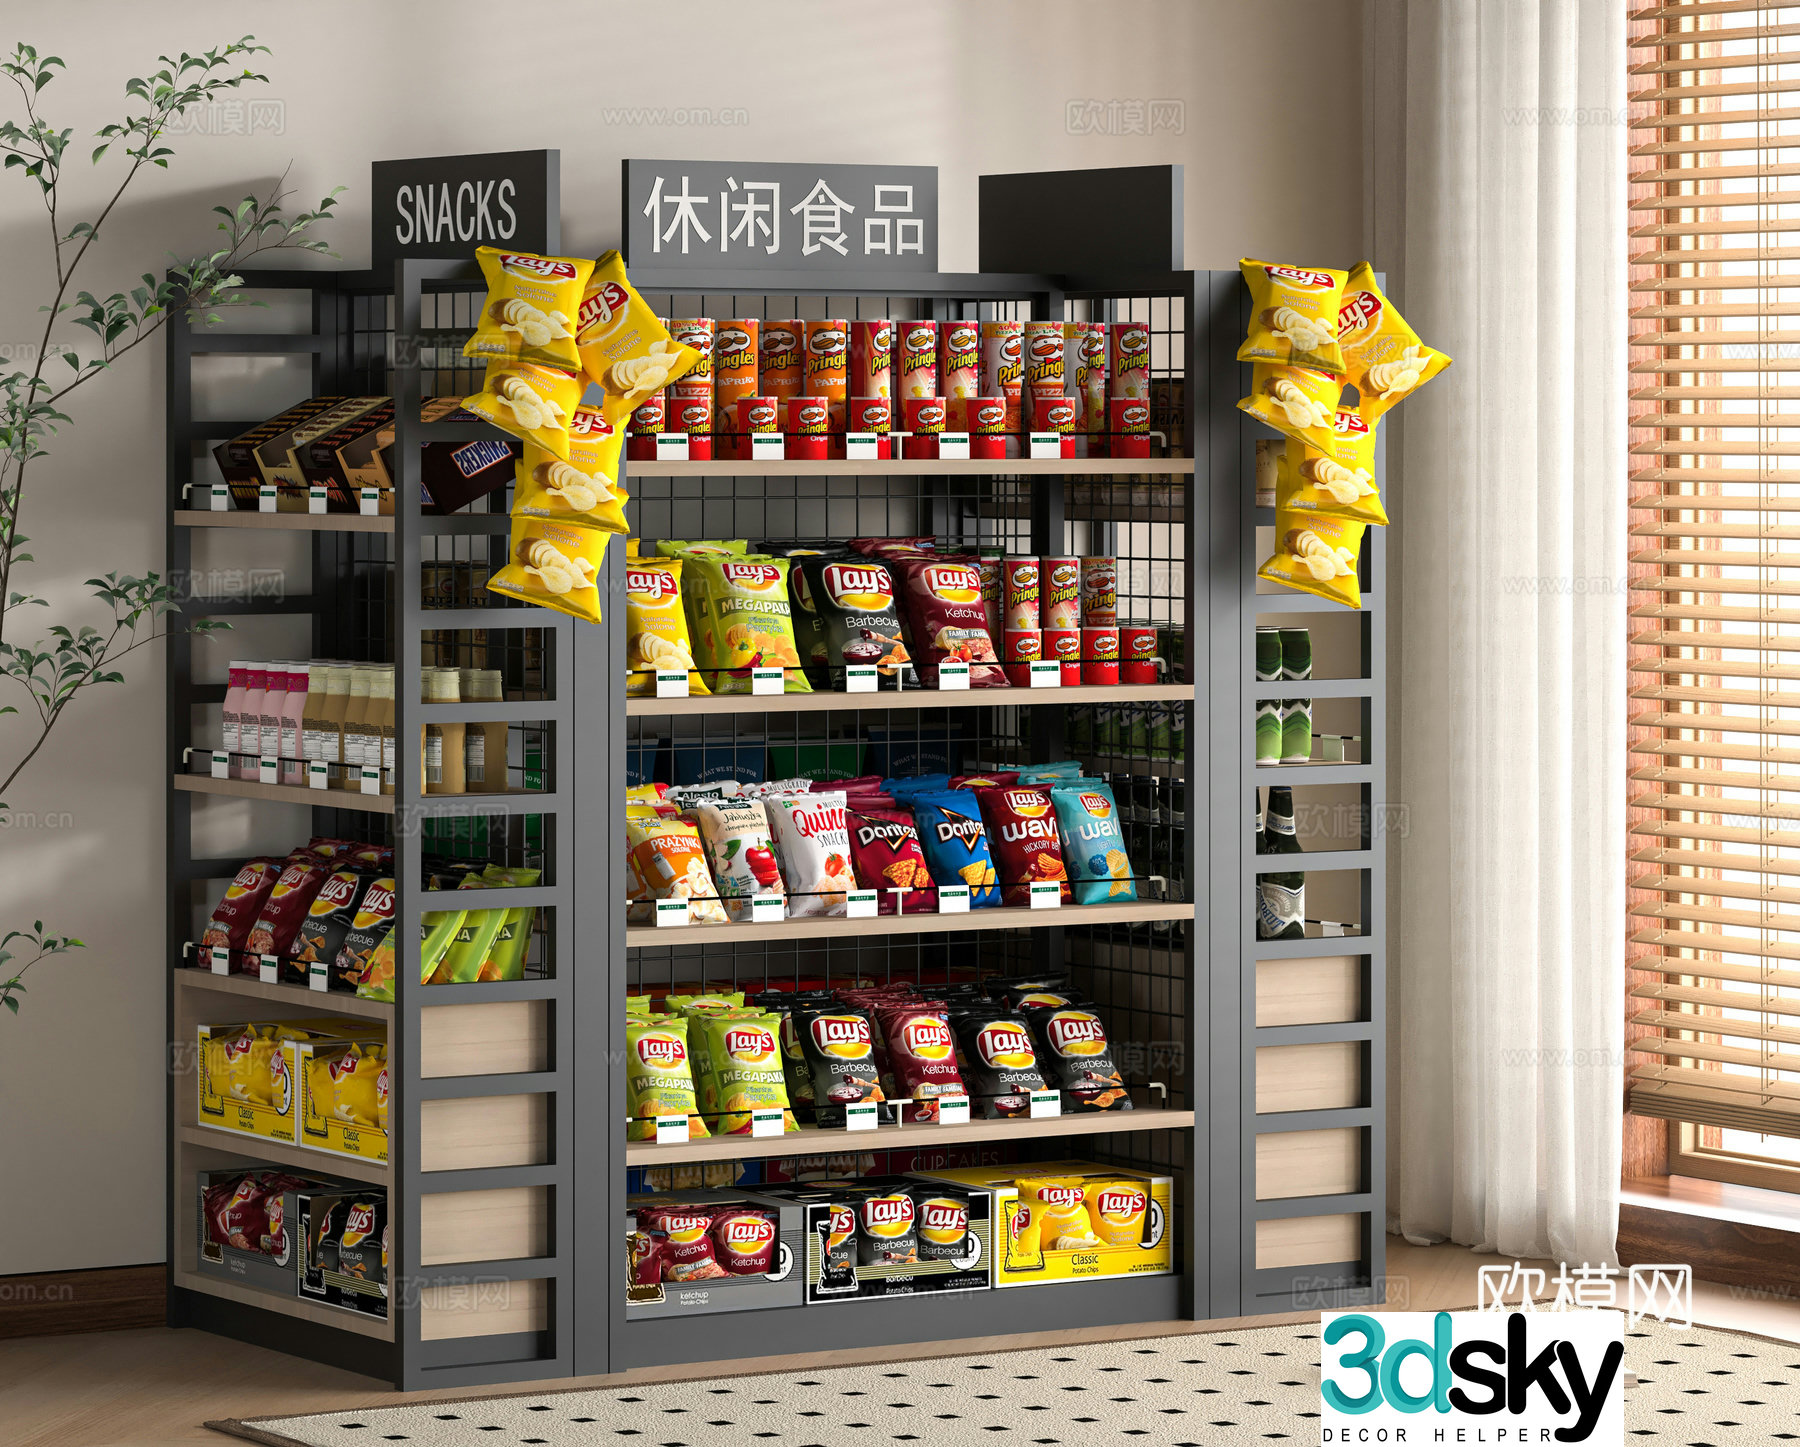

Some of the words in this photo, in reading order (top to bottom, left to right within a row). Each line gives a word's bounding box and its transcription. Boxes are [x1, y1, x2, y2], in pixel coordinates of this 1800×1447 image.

[396, 178, 516, 245] SNACKS
[643, 175, 925, 257] 休闲食品
[500, 254, 574, 277] Lay's
[1269, 266, 1330, 286] Lay's
[577, 283, 622, 337] ay's
[729, 563, 775, 585] Lay's
[832, 567, 891, 598] Lay's
[932, 568, 978, 591] Lay's
[627, 572, 674, 599] ay's
[845, 616, 900, 629] Barbecue
[944, 608, 985, 623] Ketchup
[682, 791, 719, 799] Alesto
[1009, 791, 1046, 808] Lay's
[1086, 795, 1110, 810] Lay's
[857, 823, 919, 846] Doritos
[819, 1019, 870, 1047] Lay's
[910, 1024, 949, 1050] Lay's
[1054, 1018, 1103, 1049] Lay's
[643, 1039, 683, 1063] Lay's
[731, 1031, 771, 1057] Lay's
[984, 1029, 1033, 1060] Lay's
[830, 1063, 877, 1075] Barbecue
[922, 1065, 958, 1076] Ketchup
[238, 1105, 254, 1120] Classic
[343, 1127, 360, 1142] Classic
[1043, 1187, 1085, 1207] Lay's
[1101, 1193, 1143, 1218] Lay's
[867, 1199, 912, 1227] Lay's
[920, 1206, 969, 1231] Lay's
[665, 1215, 711, 1233] Lay's
[727, 1223, 769, 1243] Lay's
[674, 1244, 708, 1258] Ketchup
[873, 1239, 915, 1252] Barbecue
[731, 1257, 766, 1267] Ketchup
[1071, 1252, 1099, 1266] Classic
[1072, 1267, 1088, 1275] Potato
[1088, 1266, 1099, 1274] Chips
[680, 1291, 709, 1301] ketchup
